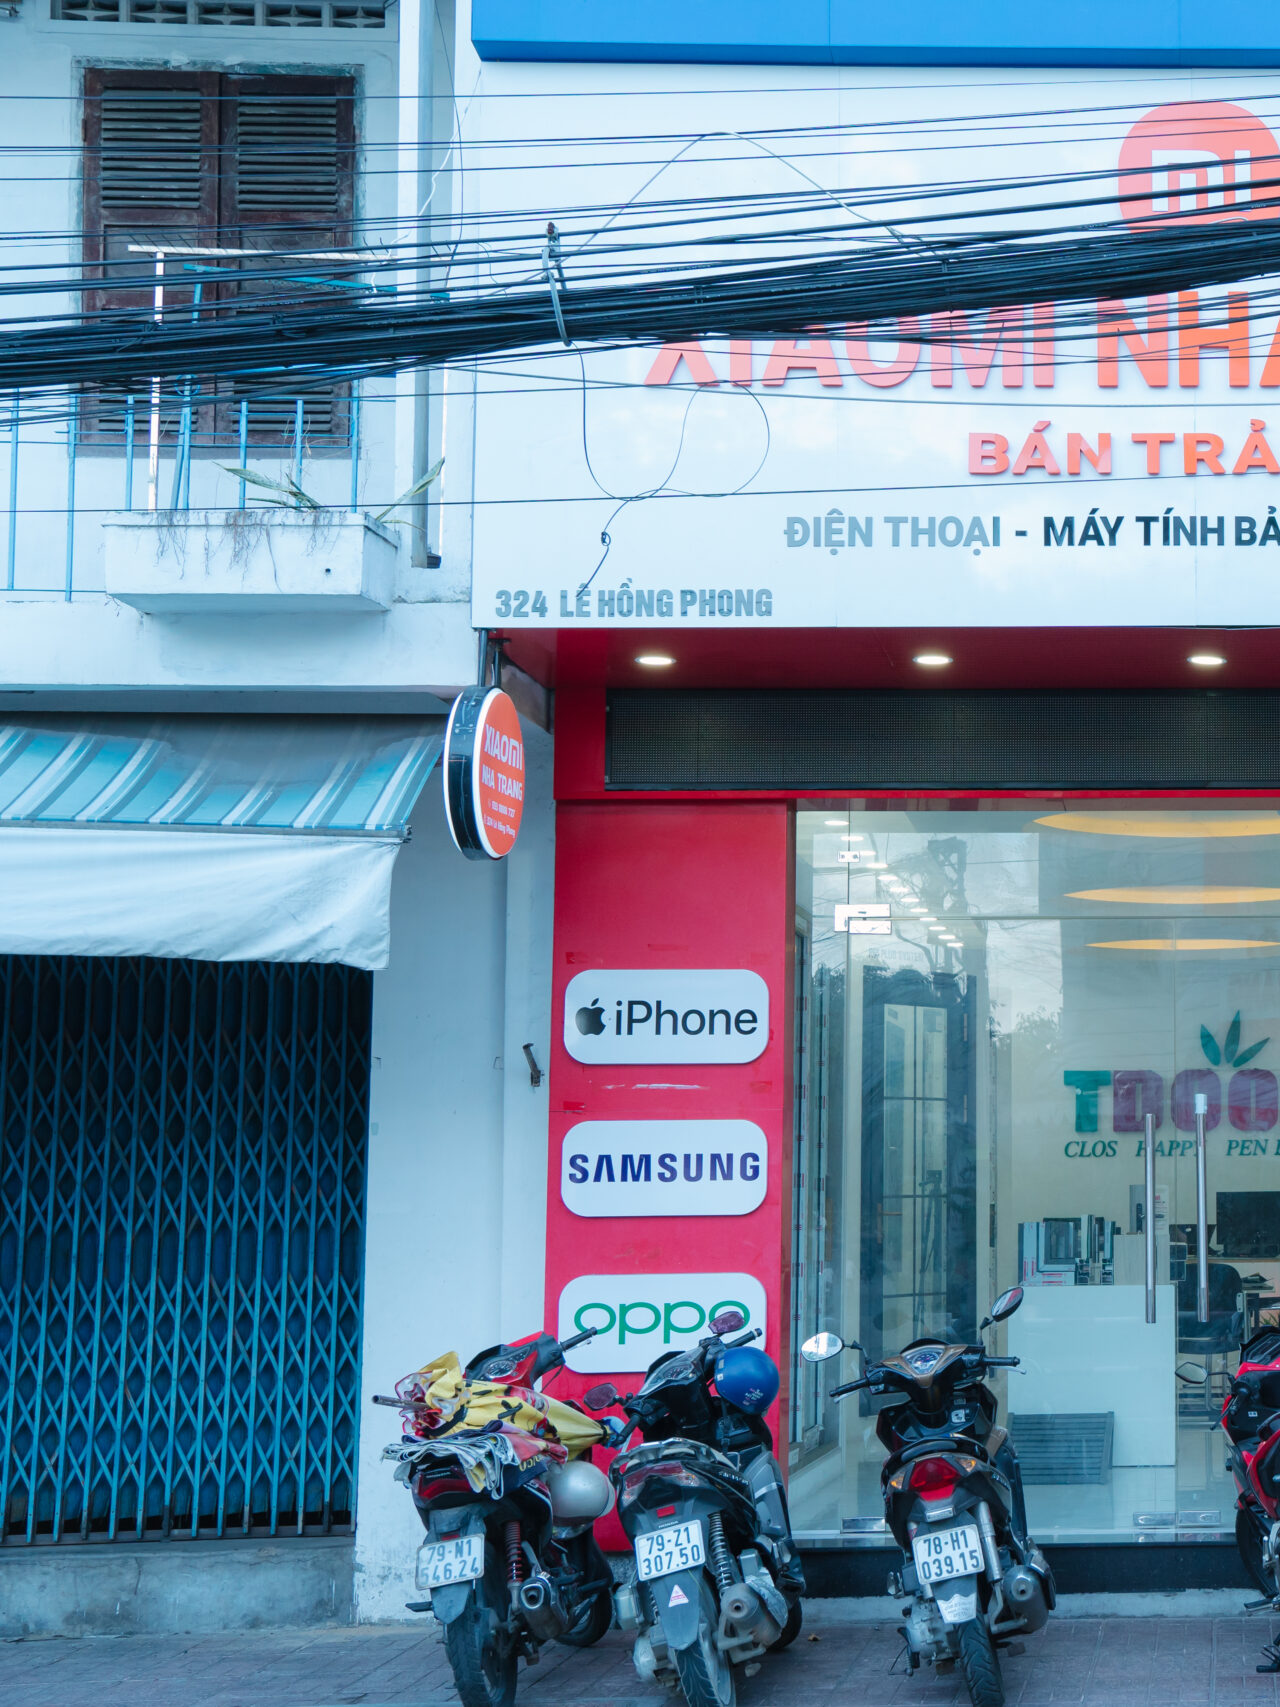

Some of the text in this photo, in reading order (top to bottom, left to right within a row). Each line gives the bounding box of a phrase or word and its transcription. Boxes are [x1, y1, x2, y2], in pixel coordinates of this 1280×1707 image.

[968, 420, 1112, 475] BÁN
[1131, 419, 1280, 476] TRẢ
[784, 508, 873, 556] ĐIỆN
[884, 516, 1001, 556] THOẠI
[1043, 507, 1124, 547] MÁY
[1136, 506, 1226, 547] TÍNH
[495, 577, 773, 618] 324 LÊ HỒNG PHONG
[484, 723, 523, 771] XIAOMI
[482, 764, 523, 801] NHA TRANG
[615, 999, 758, 1036] iPhone
[1064, 1139, 1118, 1158] CLOS
[1226, 1139, 1272, 1157] PEN
[568, 1151, 760, 1185] SAMSUNG
[573, 1299, 751, 1345] oppo
[427, 1538, 472, 1565] 79-N1
[647, 1526, 691, 1555] 79-Z1
[923, 1529, 969, 1557] 78-H1
[420, 1557, 479, 1586] 546.24
[642, 1544, 700, 1576] 307.50
[922, 1549, 980, 1580] 039.15
